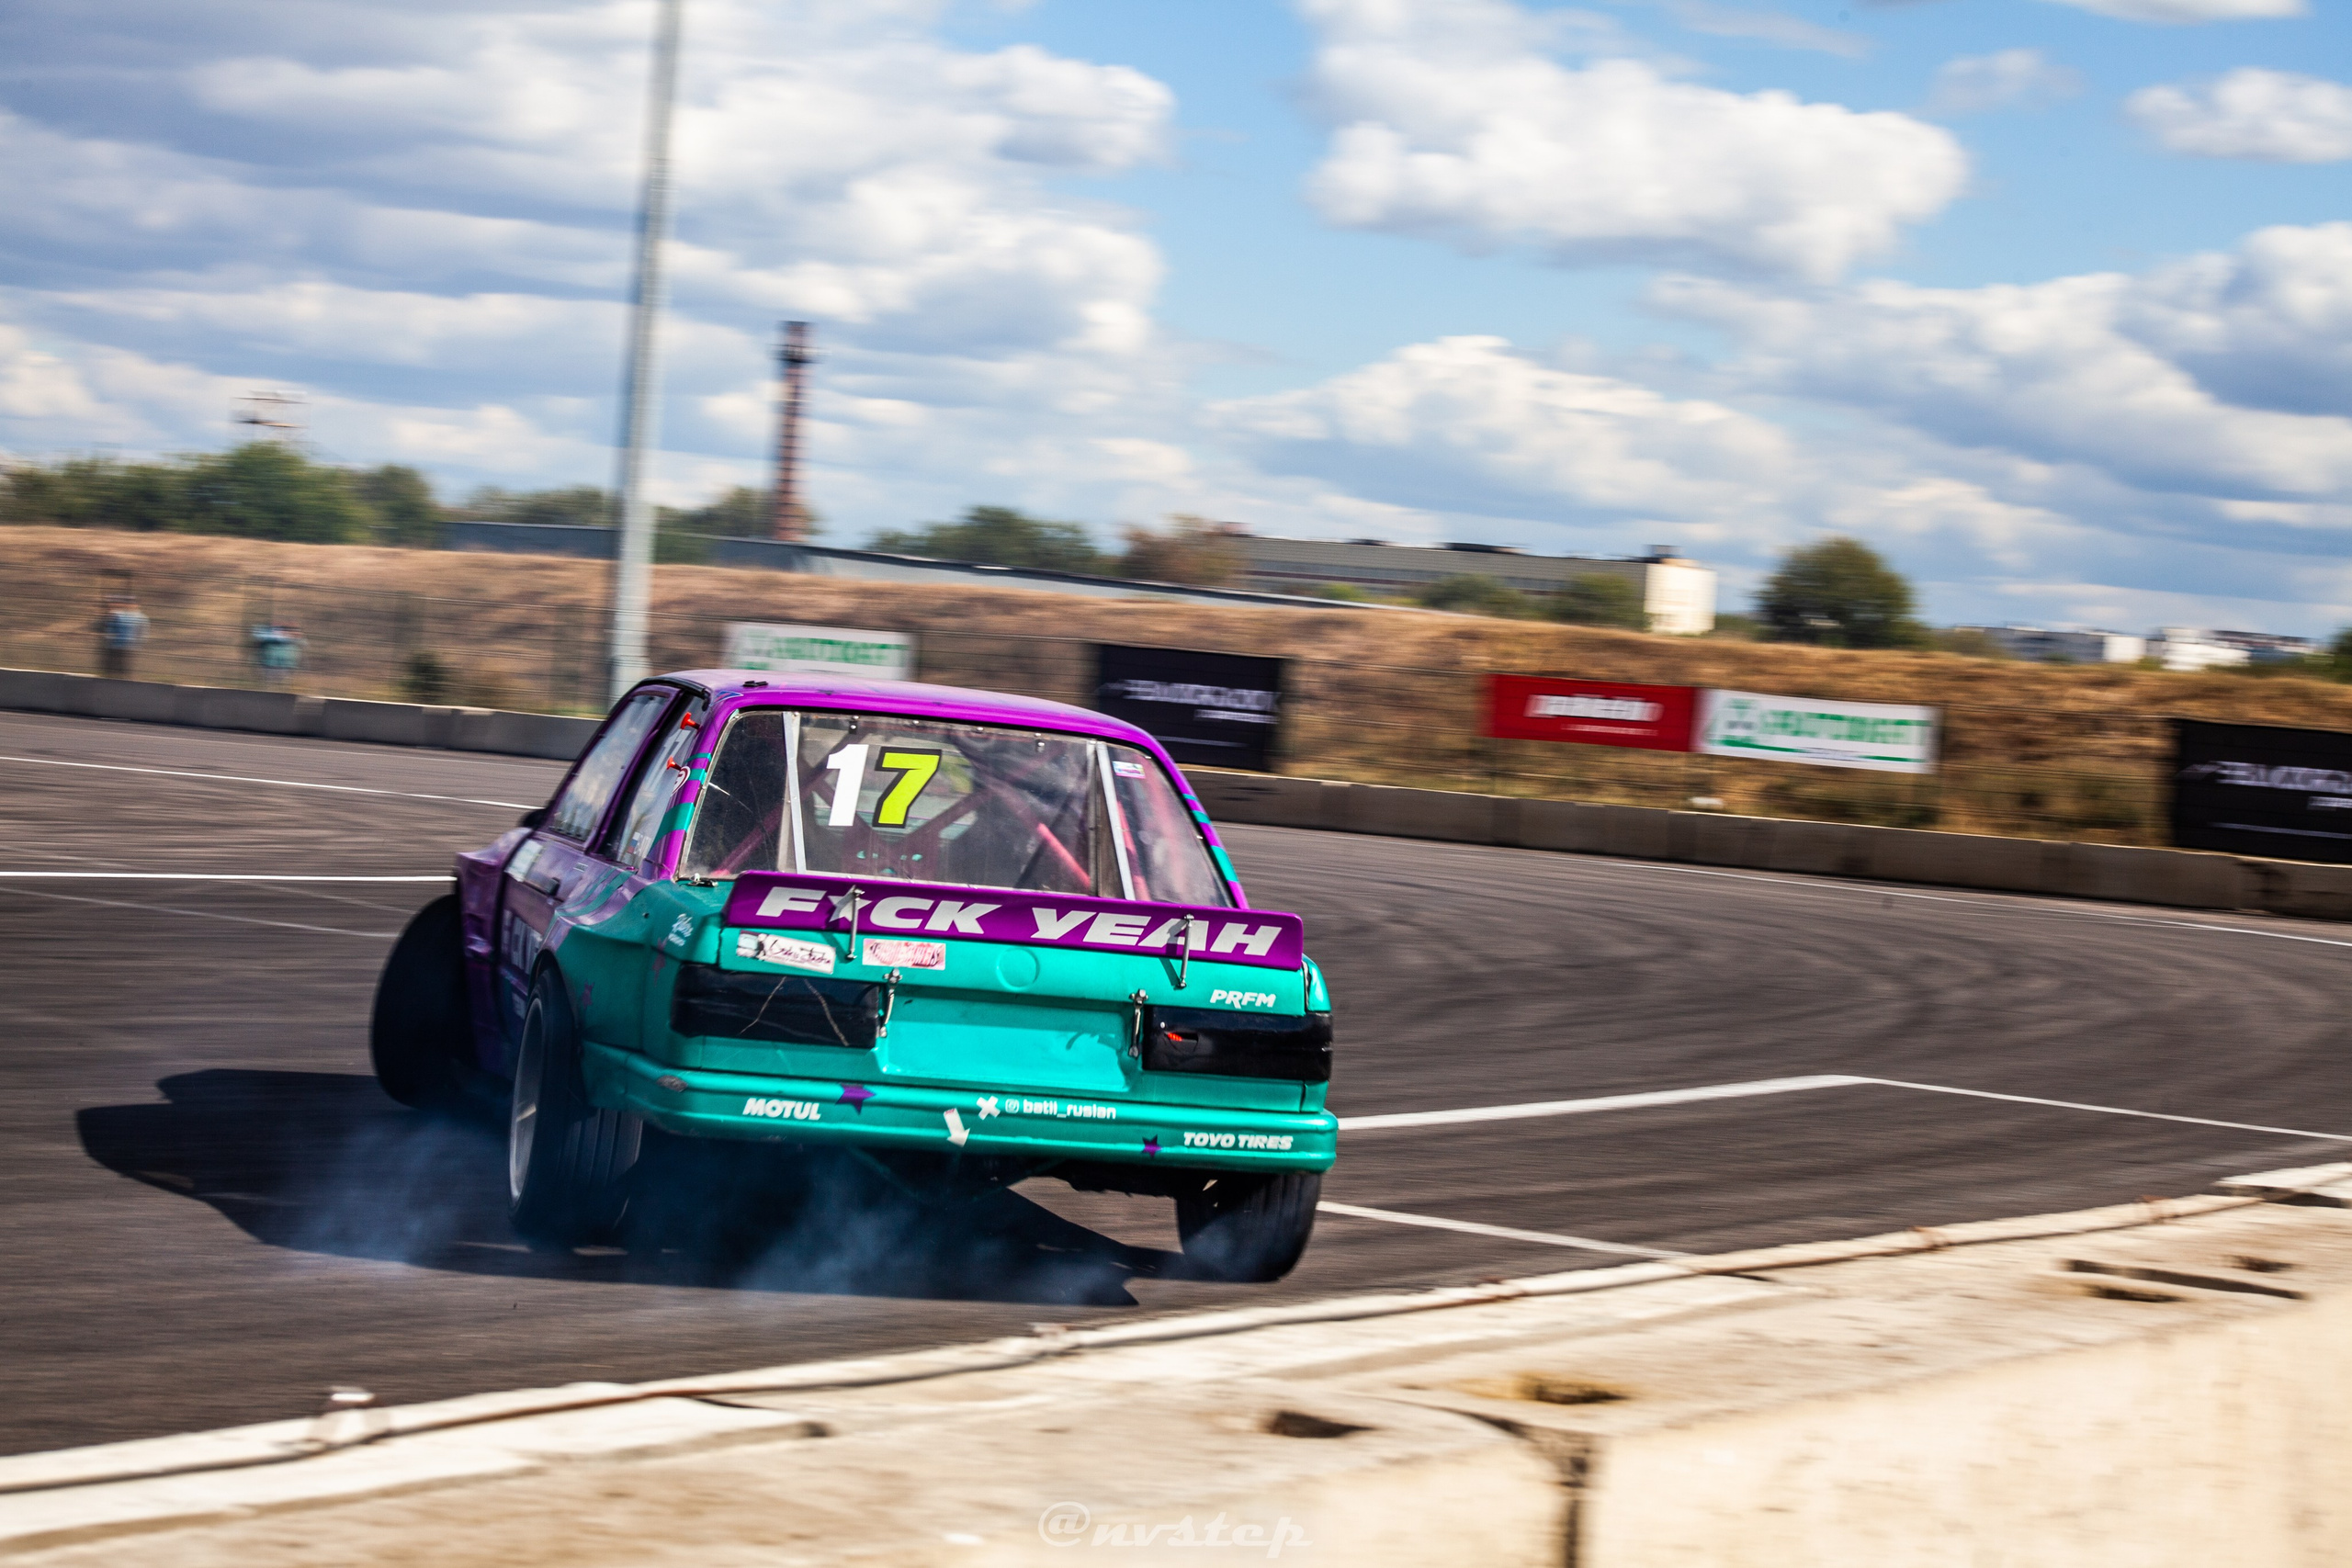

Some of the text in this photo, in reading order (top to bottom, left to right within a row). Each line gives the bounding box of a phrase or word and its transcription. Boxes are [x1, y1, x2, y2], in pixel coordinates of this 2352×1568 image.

[827, 743, 943, 829] 17
[1030, 907, 1283, 957] YEAH
[1209, 988, 1277, 1010] PRFM
[742, 1097, 821, 1121] MOTUL
[1238, 1134, 1294, 1150] TIRES
